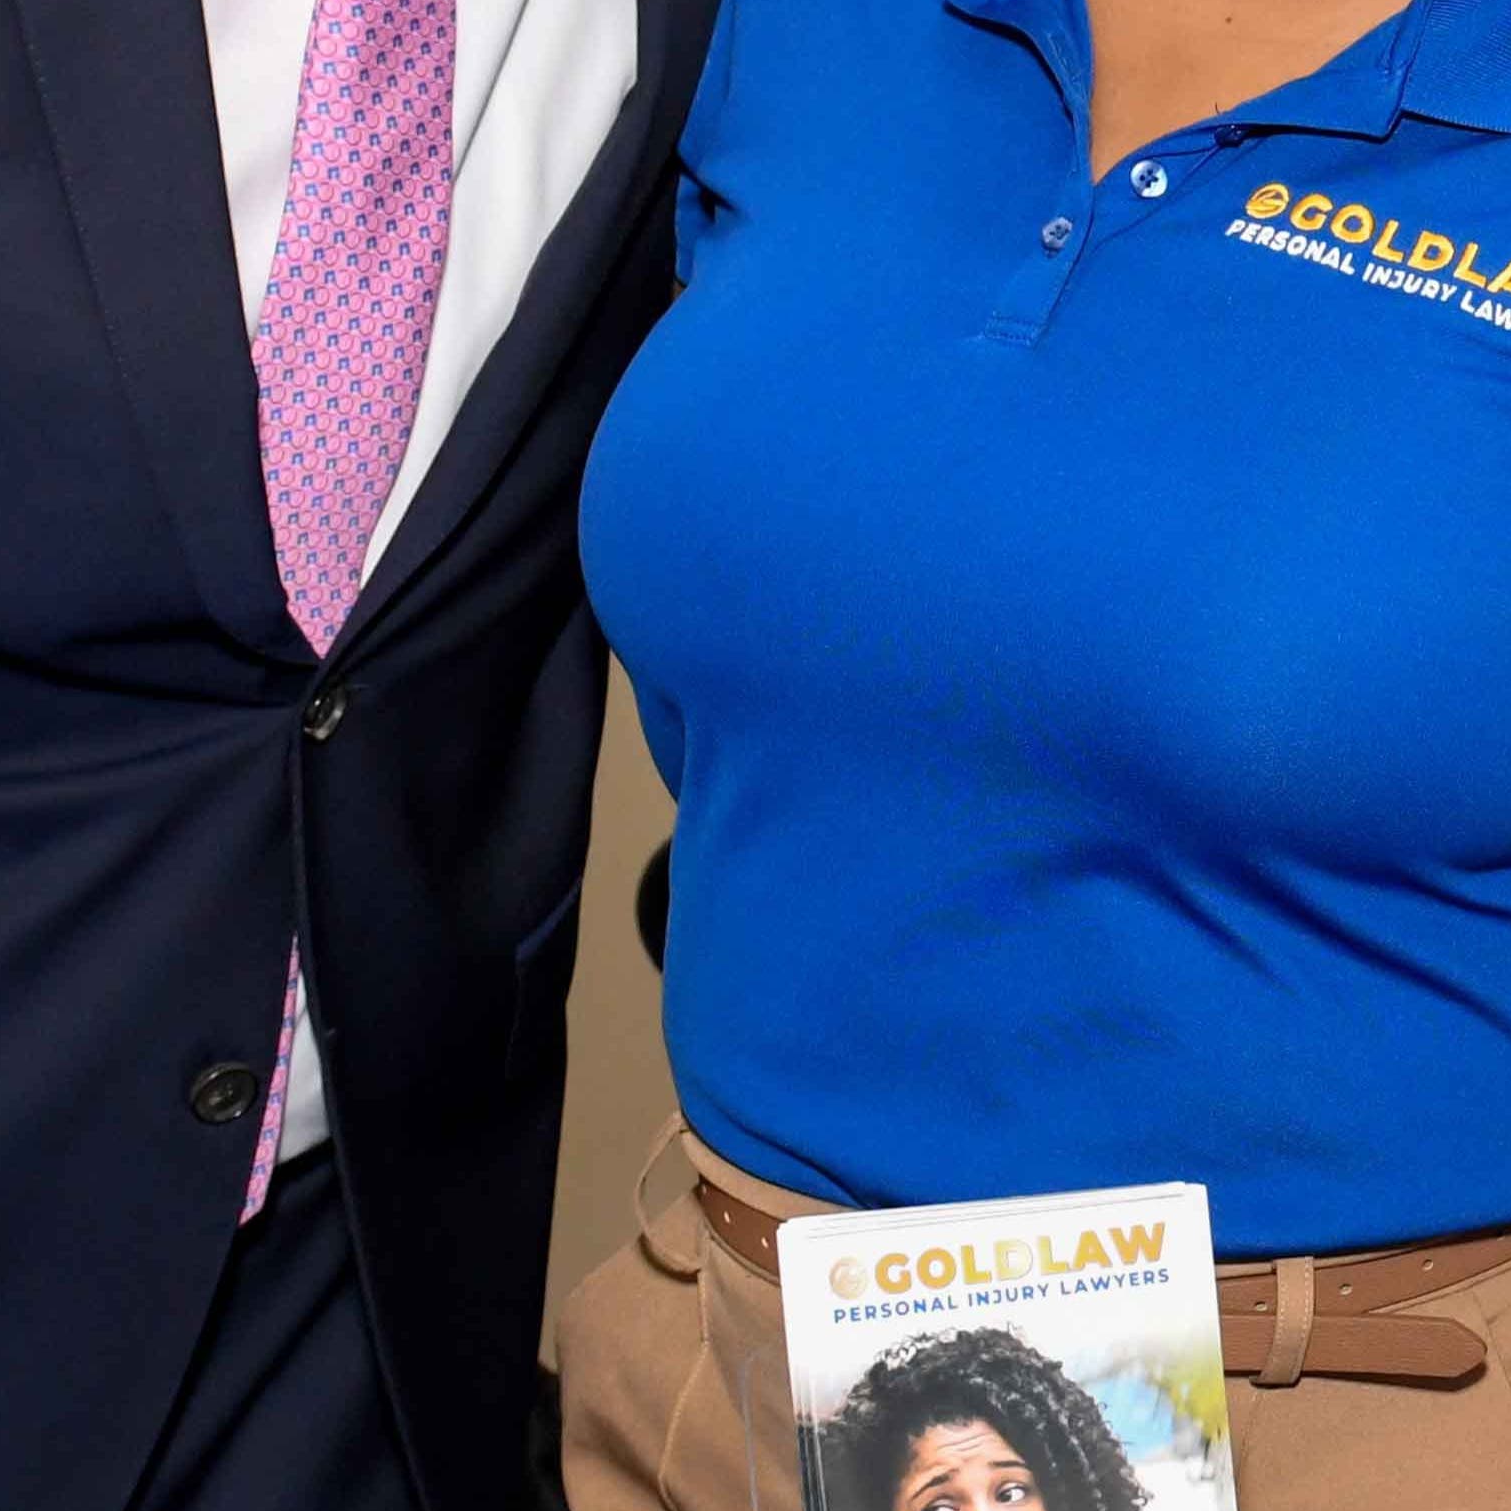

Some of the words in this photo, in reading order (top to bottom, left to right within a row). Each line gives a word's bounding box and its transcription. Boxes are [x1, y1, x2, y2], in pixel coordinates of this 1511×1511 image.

[1225, 220, 1355, 276] PERSONAL
[1362, 262, 1457, 304] INJURY
[833, 1297, 957, 1324] PERSONAL
[968, 1282, 1049, 1308] INJURY
[1060, 1267, 1169, 1296] LAWYERS
[874, 1221, 1167, 1296] GOLDLAW
